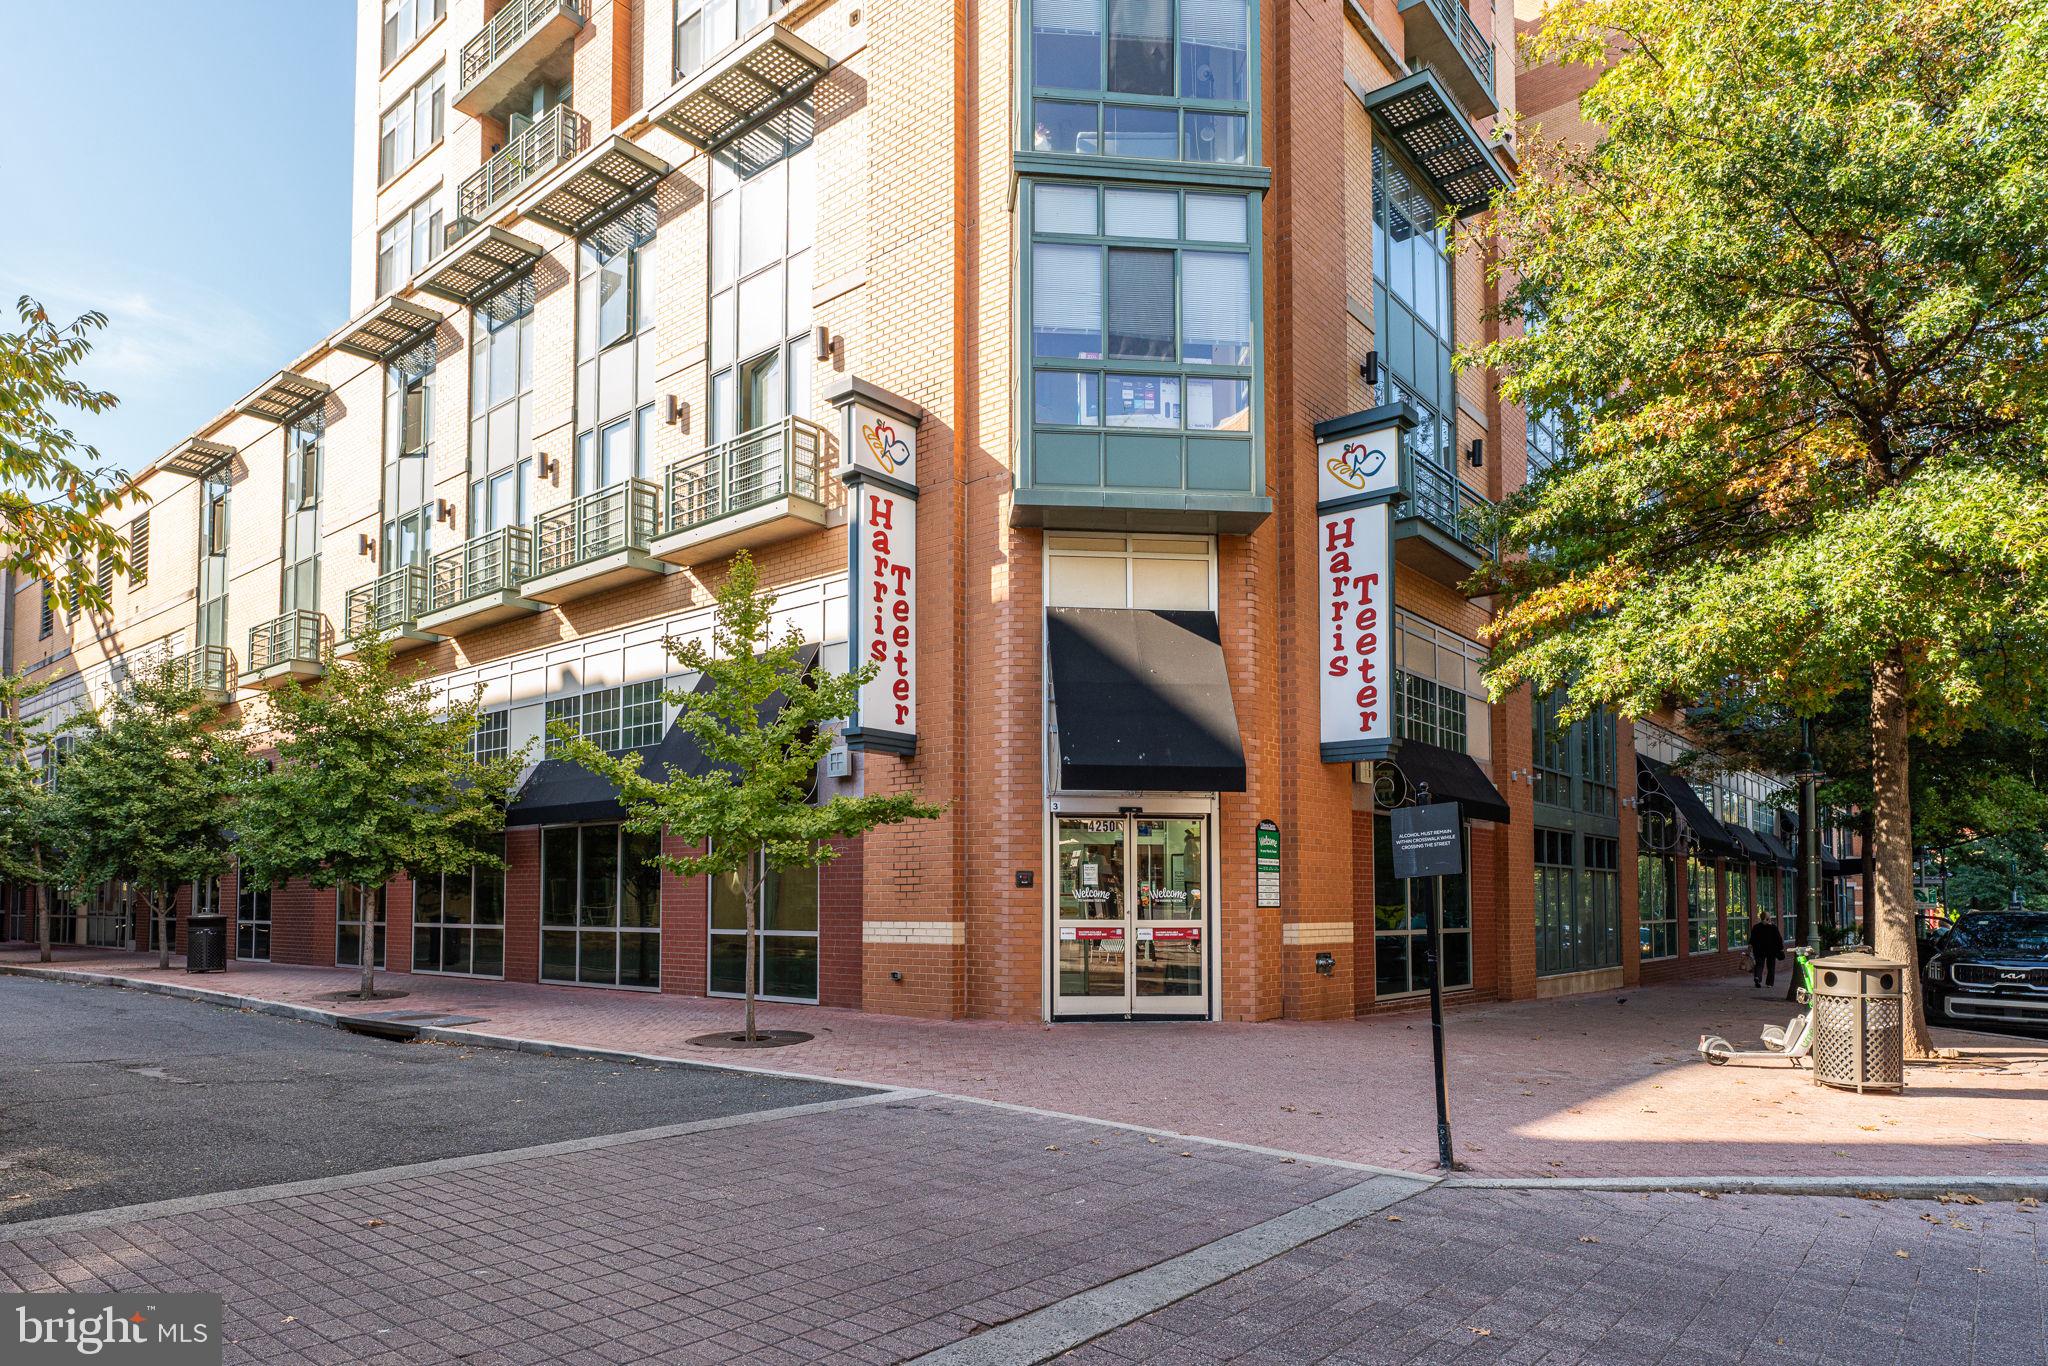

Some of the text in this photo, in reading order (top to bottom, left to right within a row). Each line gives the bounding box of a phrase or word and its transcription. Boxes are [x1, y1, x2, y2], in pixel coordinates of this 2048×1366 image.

[869, 495, 911, 726] Harris Teeter
[1325, 517, 1378, 732] Harris Teeter
[1053, 802, 1058, 810] 3
[1088, 820, 1115, 832] 4250
[1072, 887, 1110, 899] Welcome
[1150, 887, 1187, 899] Welcome
